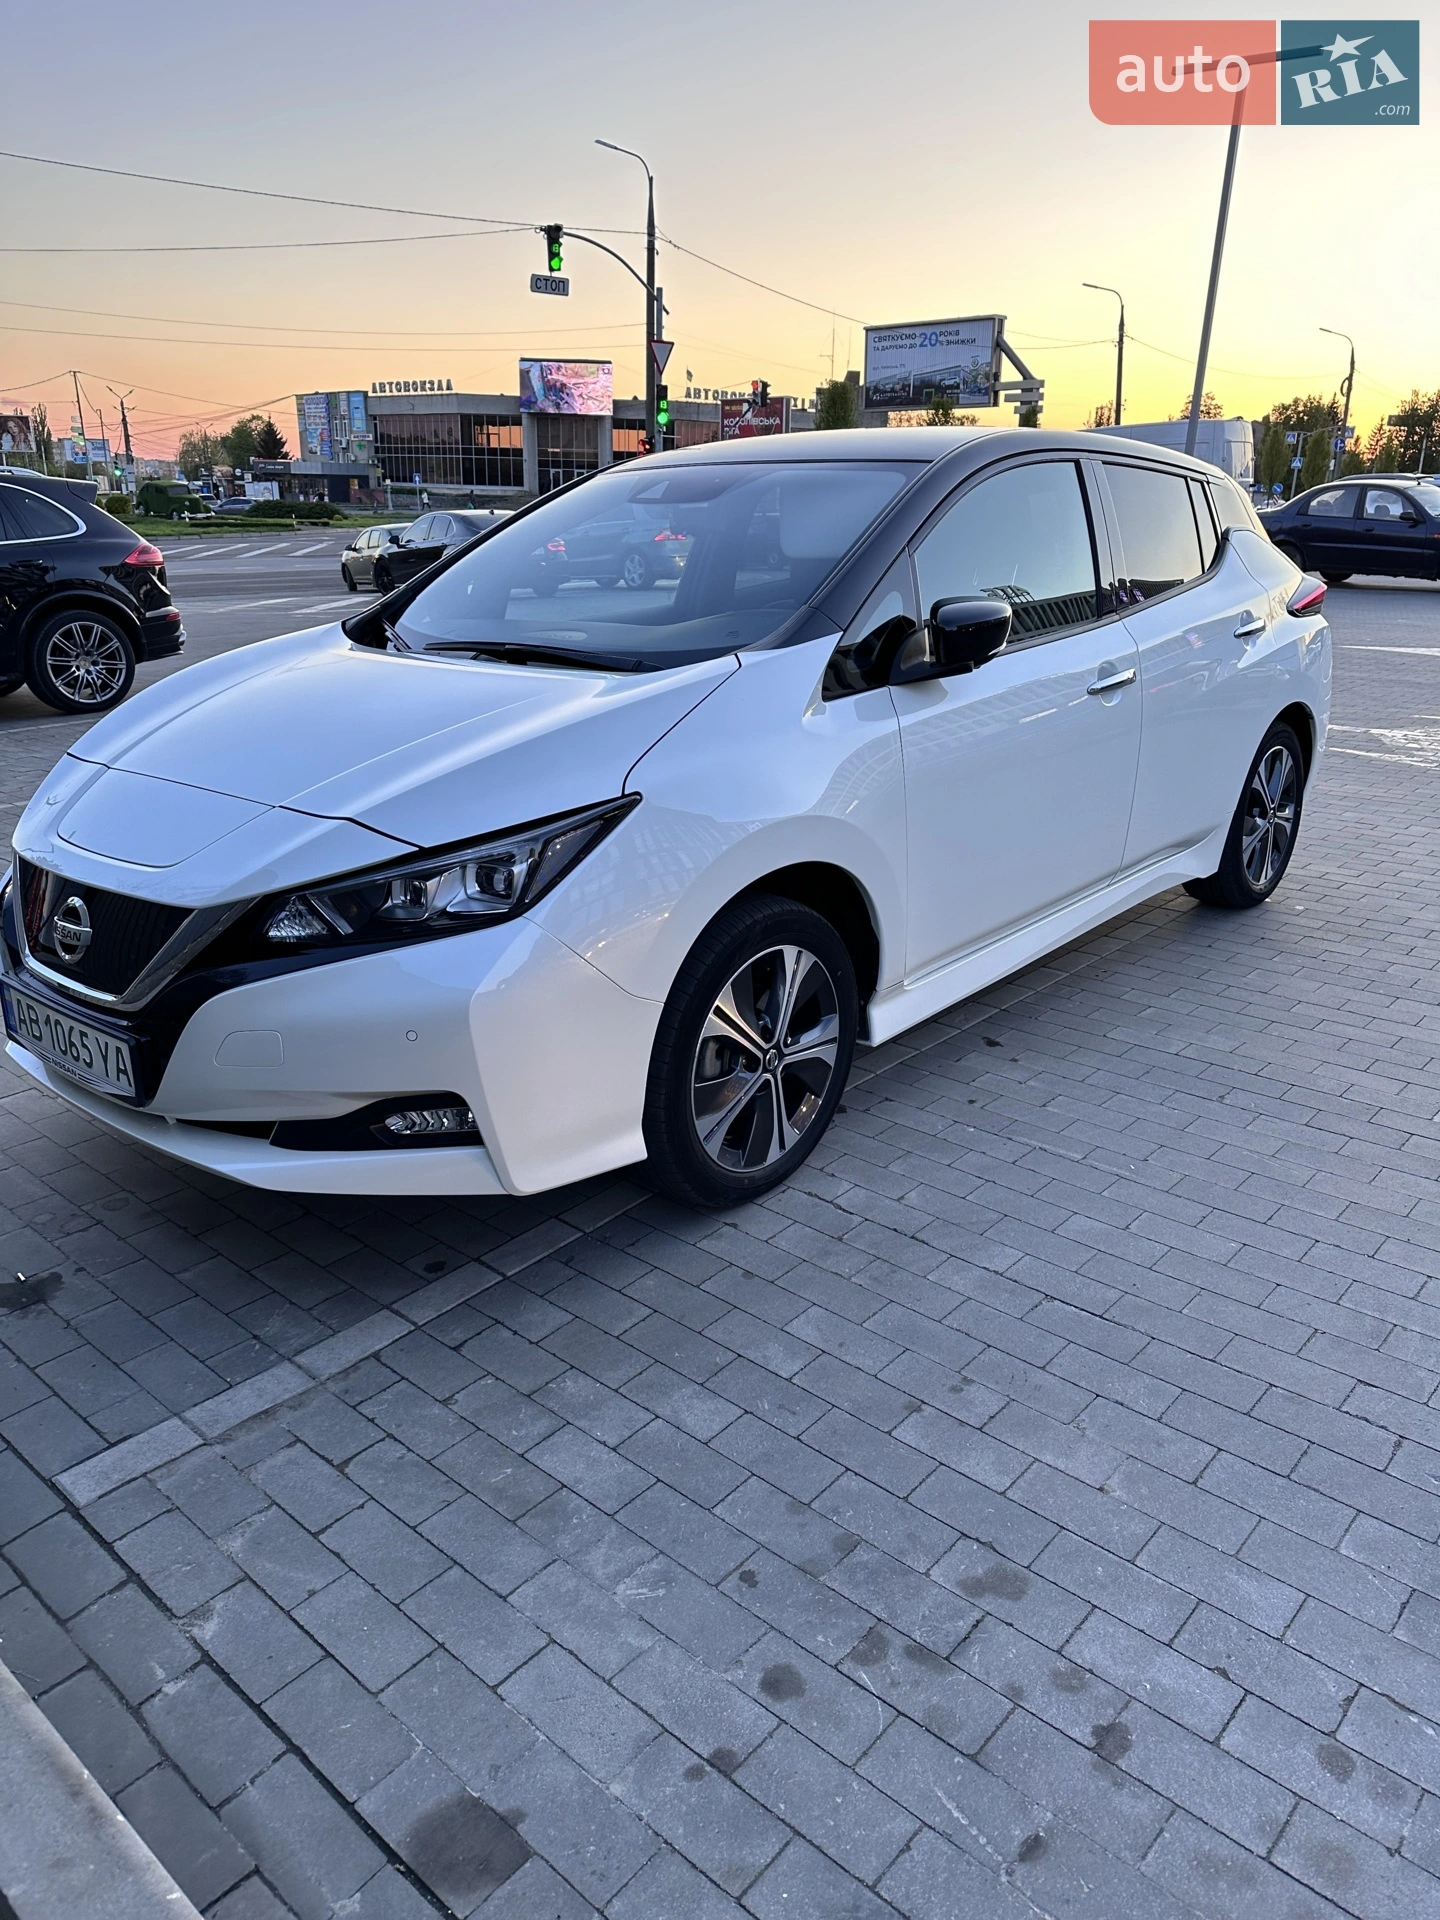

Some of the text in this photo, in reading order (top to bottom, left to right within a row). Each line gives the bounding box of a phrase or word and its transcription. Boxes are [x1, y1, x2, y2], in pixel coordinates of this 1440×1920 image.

[535, 277, 565, 292] СТОП
[873, 330, 960, 348] СВЯТКУЄМО 20 РОКІВ
[908, 342, 917, 350] ДО
[945, 338, 976, 346] ЗНИЖКИ
[372, 379, 453, 393] АВТОВОКЗАЛ
[51, 1057, 78, 1078] NISSAN
